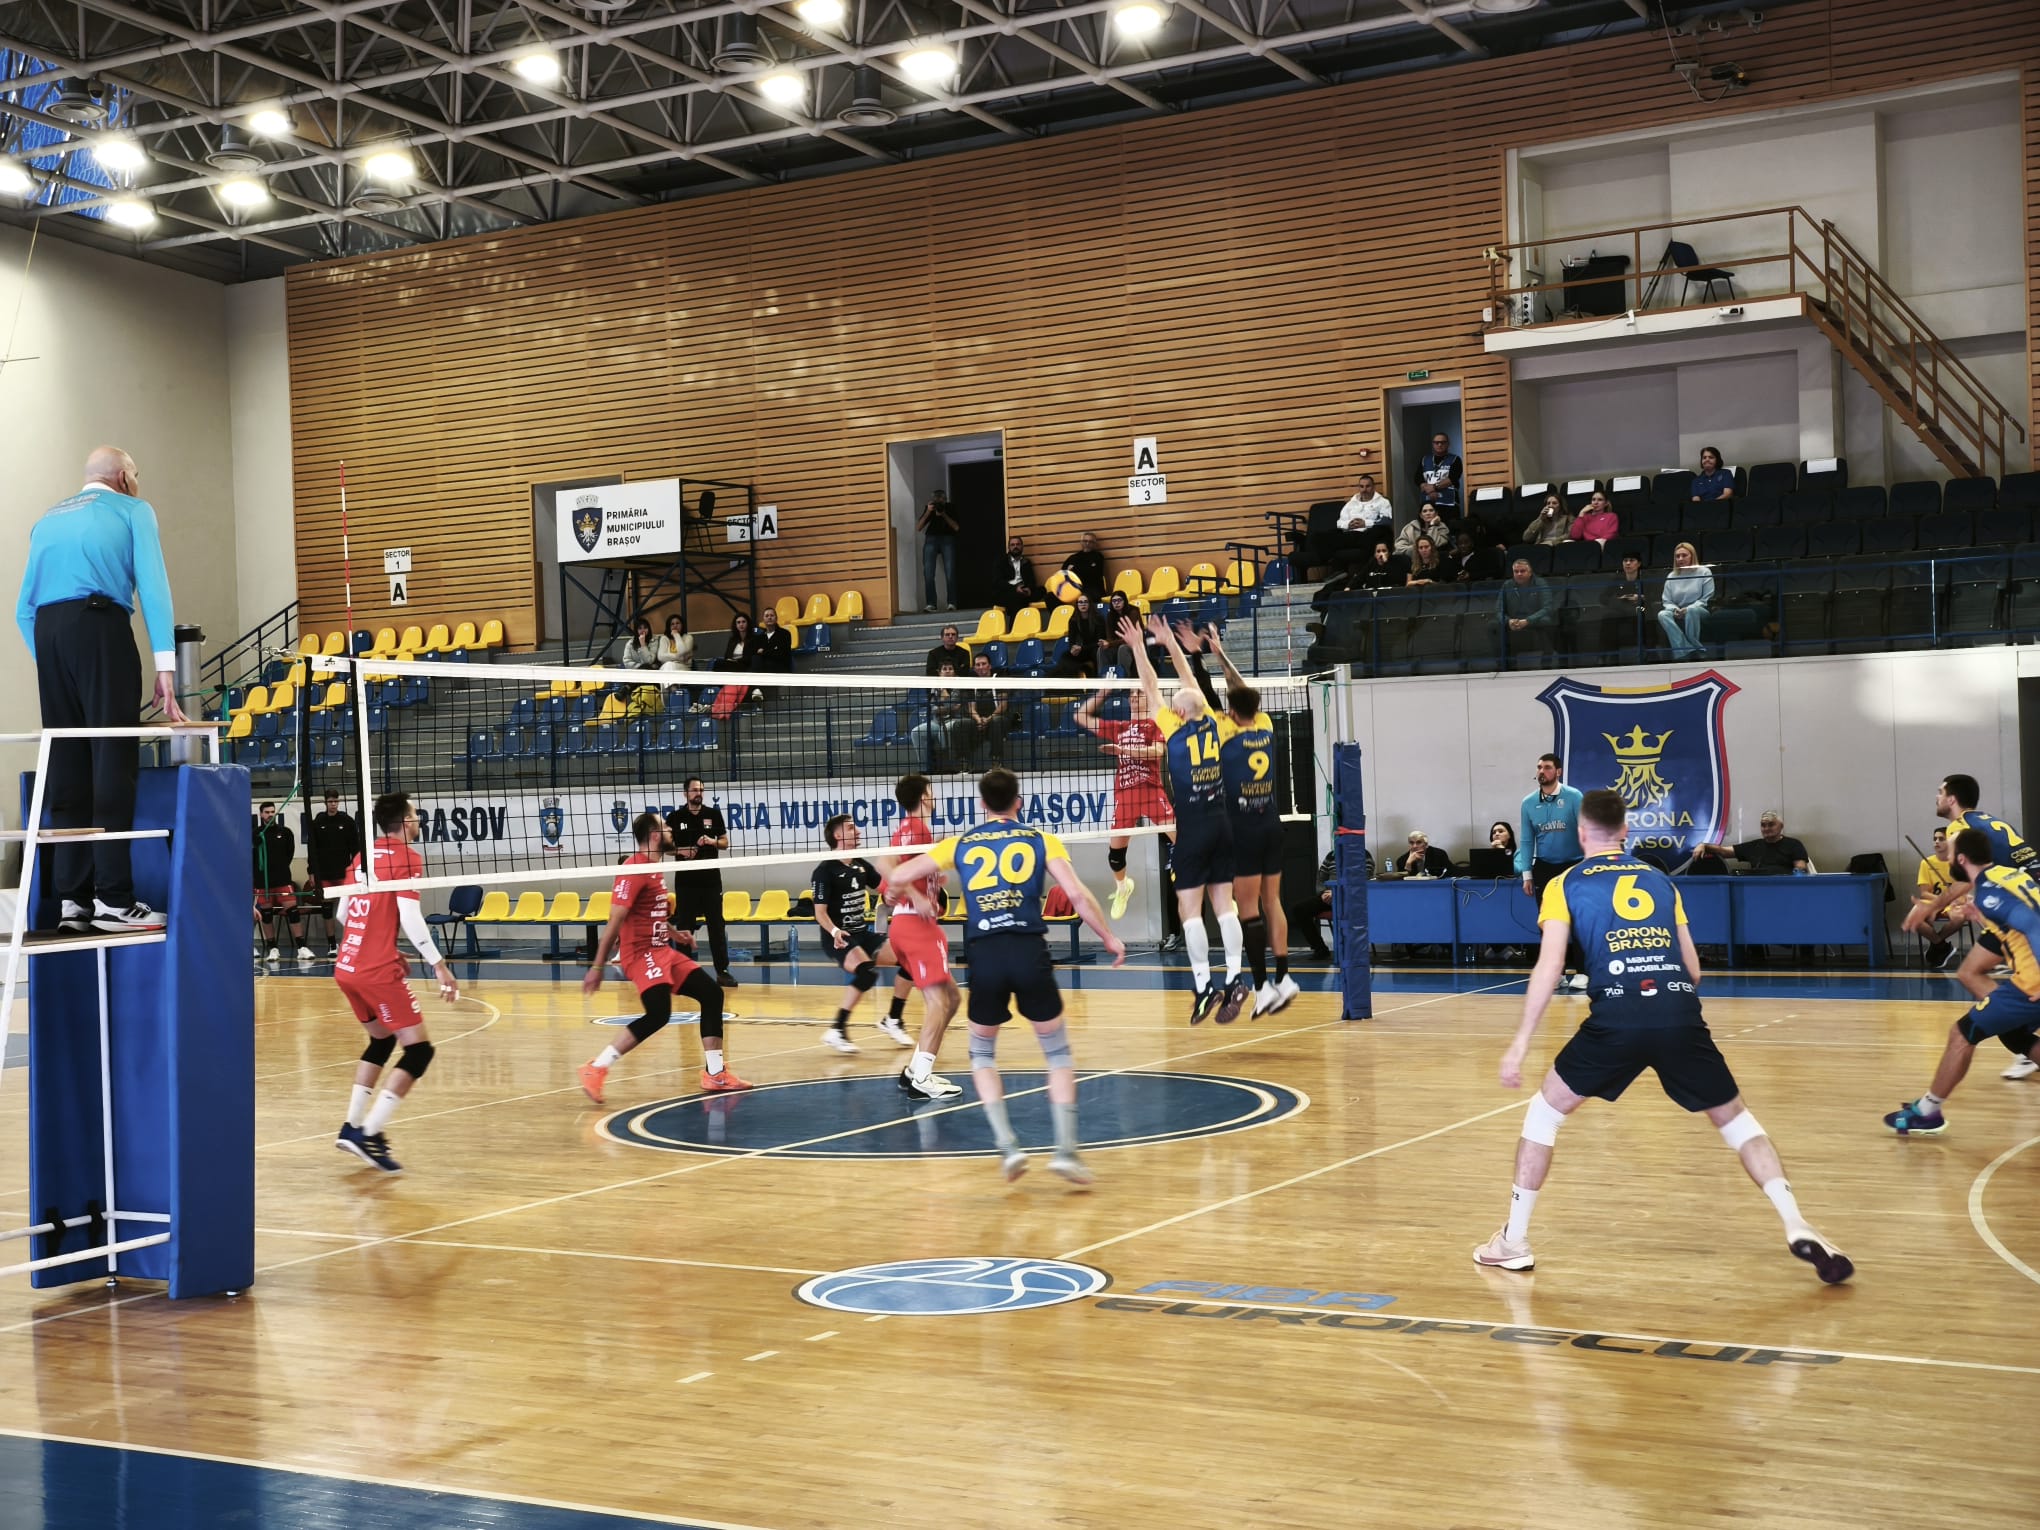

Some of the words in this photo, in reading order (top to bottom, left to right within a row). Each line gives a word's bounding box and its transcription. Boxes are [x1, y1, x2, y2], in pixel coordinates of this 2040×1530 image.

[1137, 446, 1155, 470] A
[1129, 477, 1165, 488] SECTOR
[1144, 490, 1151, 501] 3
[606, 507, 648, 520] PRIMĂRIA
[606, 519, 665, 533] MUNICIPIULUI
[760, 514, 776, 536] A
[607, 534, 641, 547] BRAȘOV
[739, 528, 746, 539] 2
[385, 549, 410, 558] SECTOR
[396, 560, 400, 570] 1
[392, 582, 406, 602] A
[1186, 731, 1220, 767] 14
[1247, 750, 1270, 781] 9
[415, 806, 507, 853] RAȘOV
[1989, 820, 2025, 847] 2
[962, 841, 1036, 891] 20
[851, 877, 859, 889] 4
[1612, 874, 1656, 921] 6
[1605, 926, 1672, 942] CORONA
[644, 966, 664, 980] 12
[1133, 1279, 1399, 1310] FIBA
